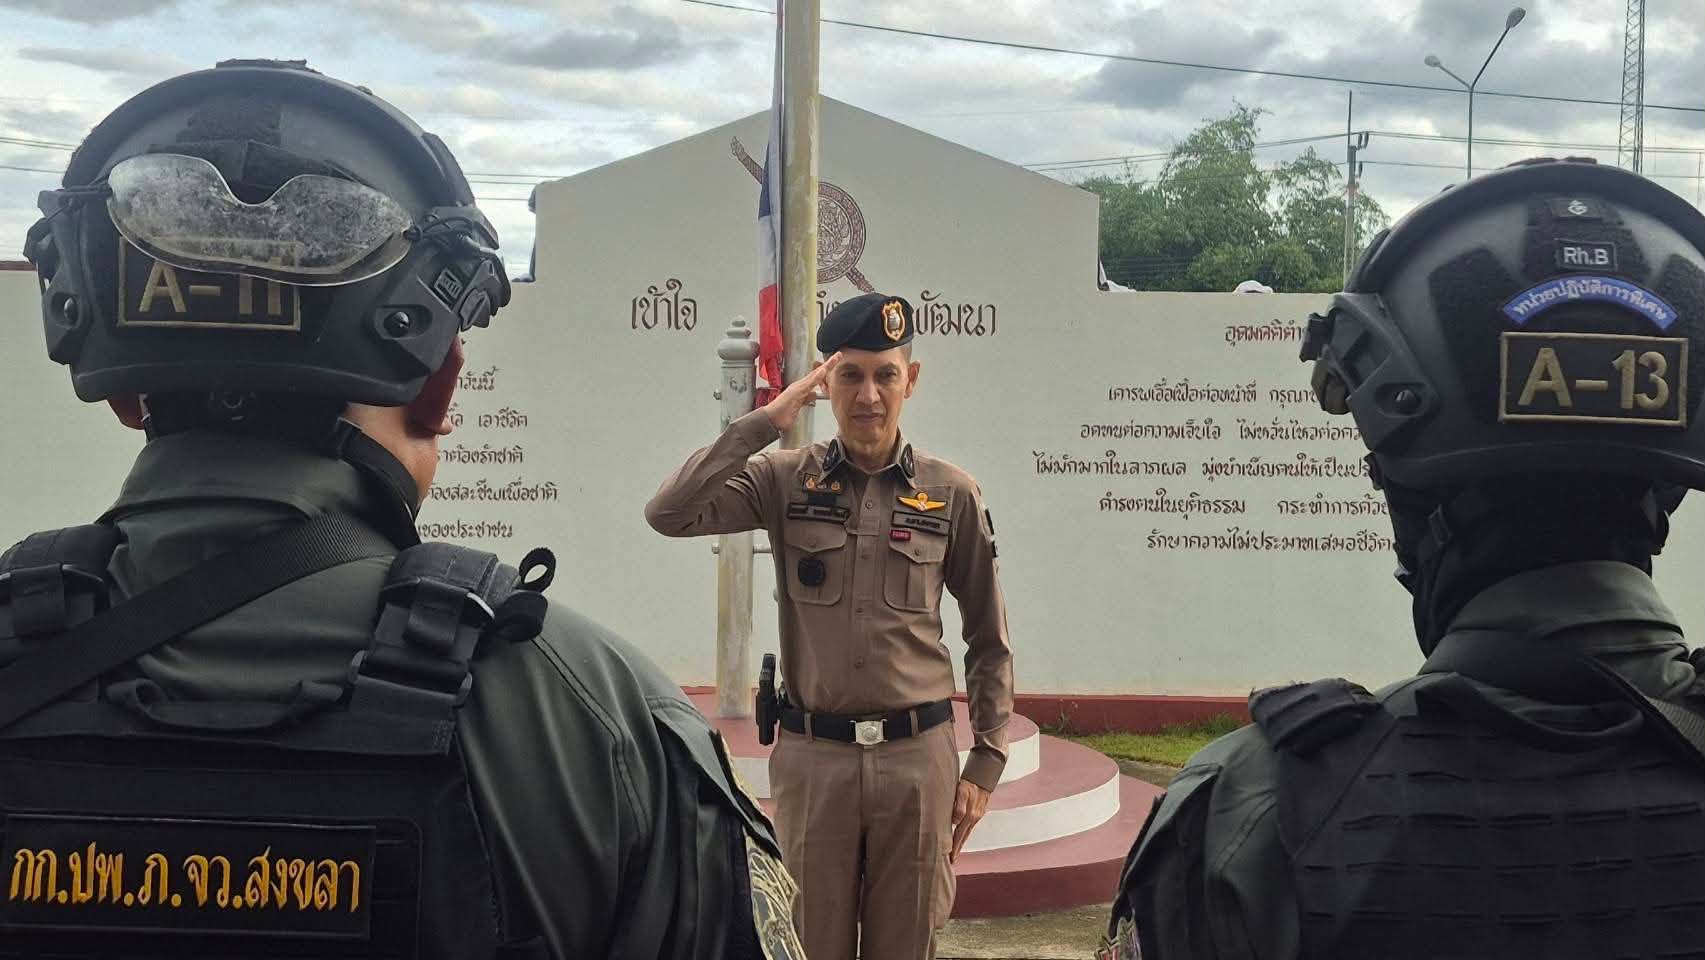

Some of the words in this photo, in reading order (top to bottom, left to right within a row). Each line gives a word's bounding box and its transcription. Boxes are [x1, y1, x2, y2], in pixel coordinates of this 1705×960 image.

[1562, 245, 1609, 266] Rh.B
[631, 278, 698, 331] เข้าใจ
[1225, 319, 1306, 347] อุดมคติตำ
[1517, 347, 1670, 411] A-13
[437, 444, 523, 465] าต้องรักชาติ
[9, 841, 361, 912] กก.ปพ.ภ.จว.สงขลา
